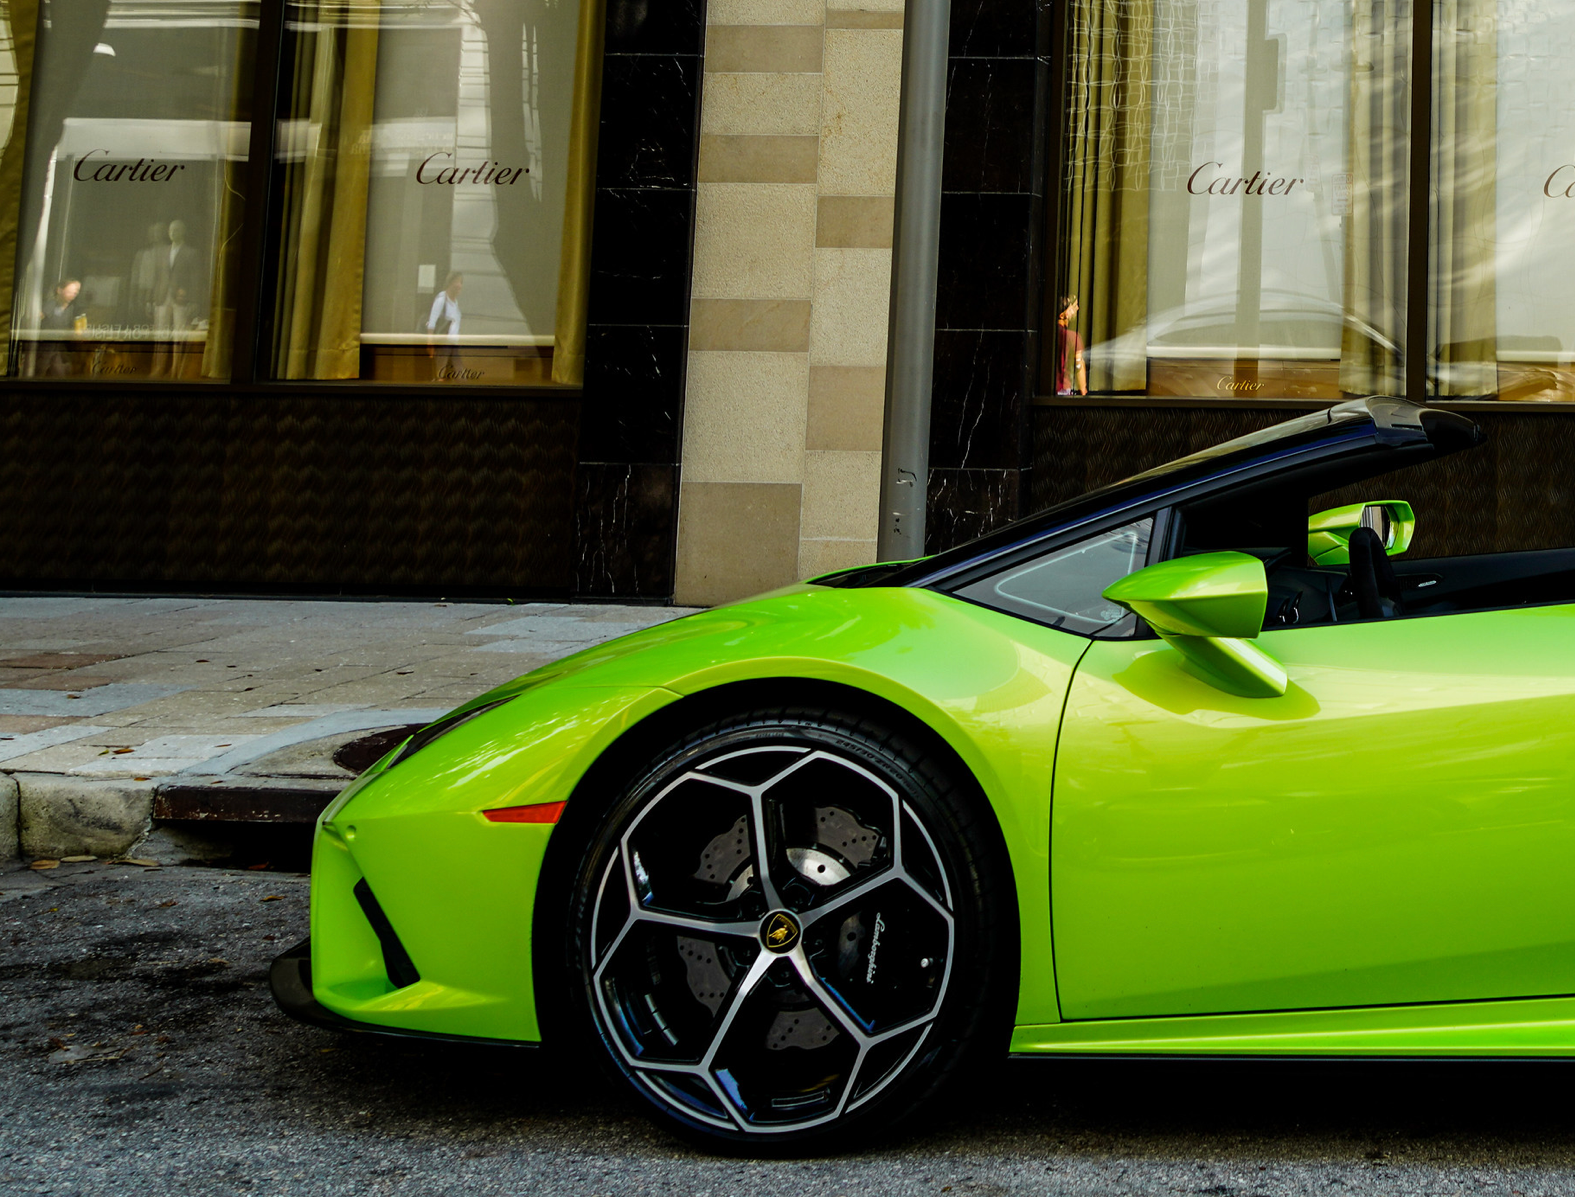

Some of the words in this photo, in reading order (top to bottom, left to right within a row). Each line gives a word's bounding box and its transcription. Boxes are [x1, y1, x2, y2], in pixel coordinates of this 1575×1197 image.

[73, 148, 187, 183] Cartier
[416, 151, 530, 185] Cartier
[1186, 161, 1305, 197] Cartier
[438, 365, 485, 380] Cartier
[1216, 374, 1265, 392] Cartier
